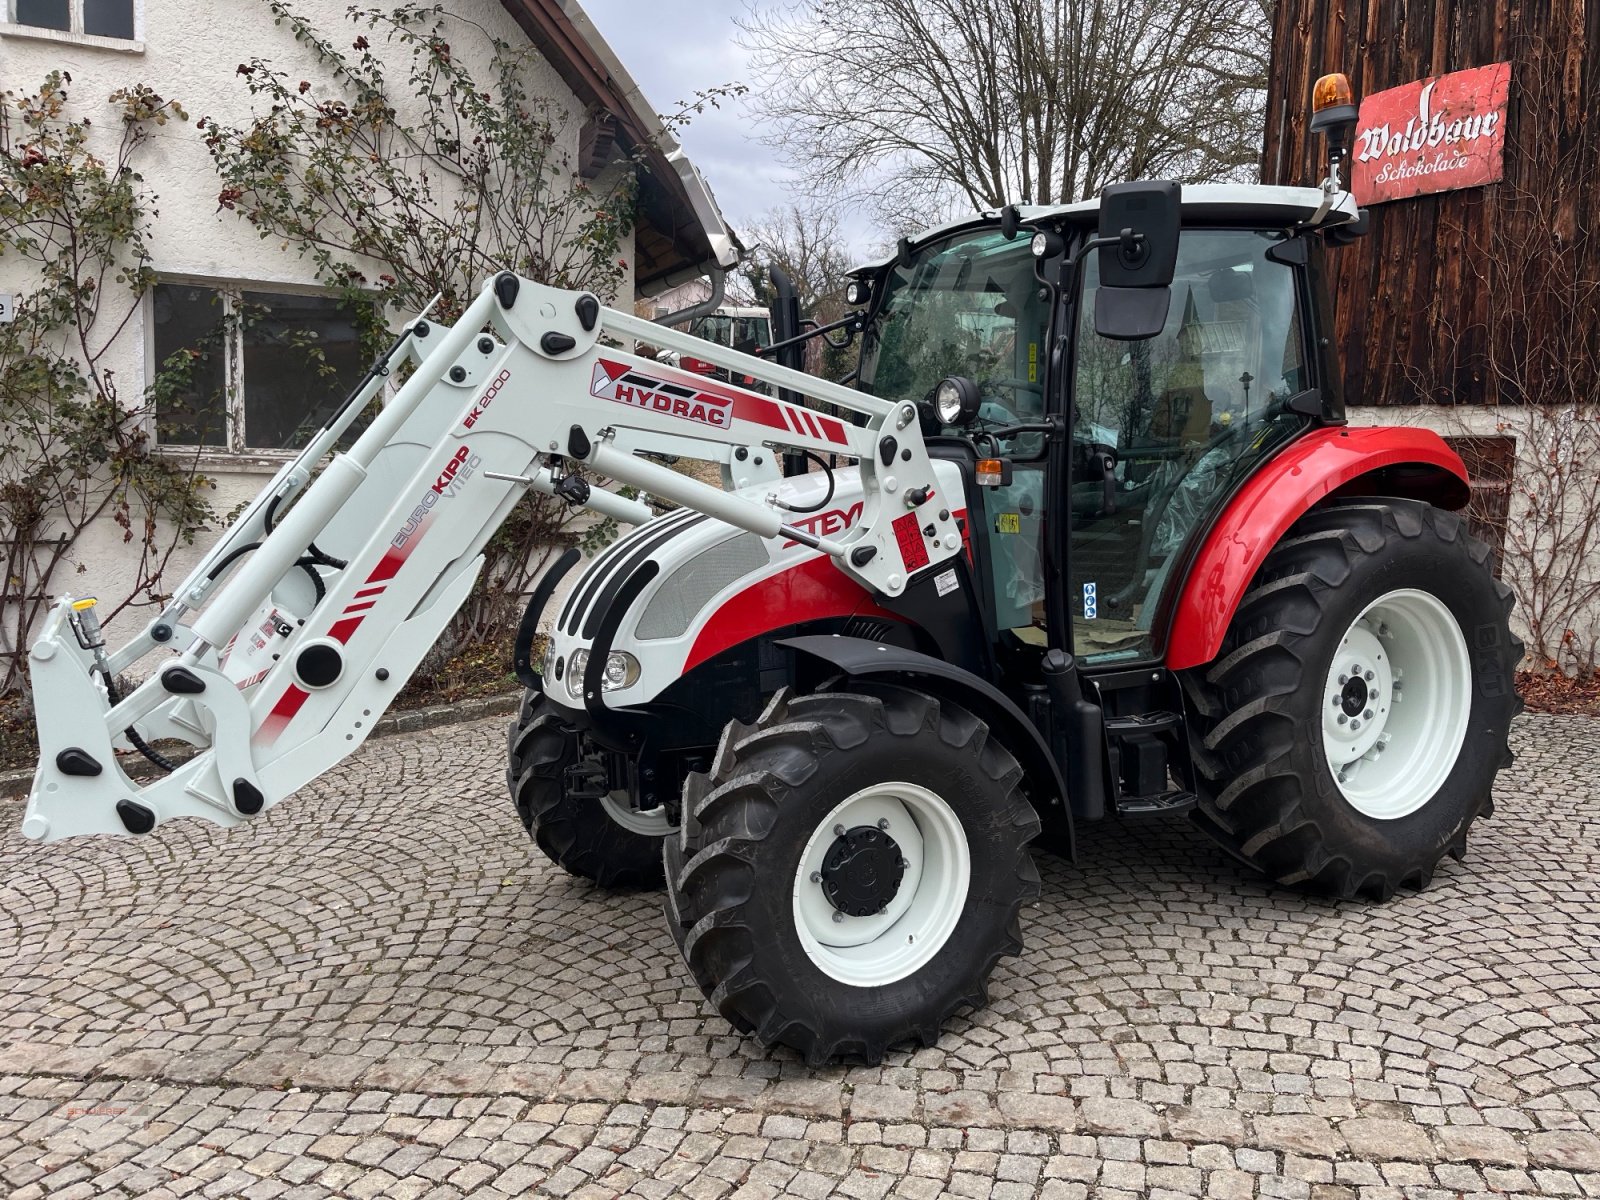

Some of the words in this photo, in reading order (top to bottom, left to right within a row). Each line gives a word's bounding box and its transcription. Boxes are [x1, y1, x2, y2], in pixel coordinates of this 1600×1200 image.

[1358, 80, 1500, 163] Waldbaur
[1375, 149, 1469, 184] Schokolade
[463, 406, 484, 429] EK
[479, 368, 511, 409] 2000
[614, 384, 725, 425] HYDRAC
[390, 445, 470, 550] EUROKIPP
